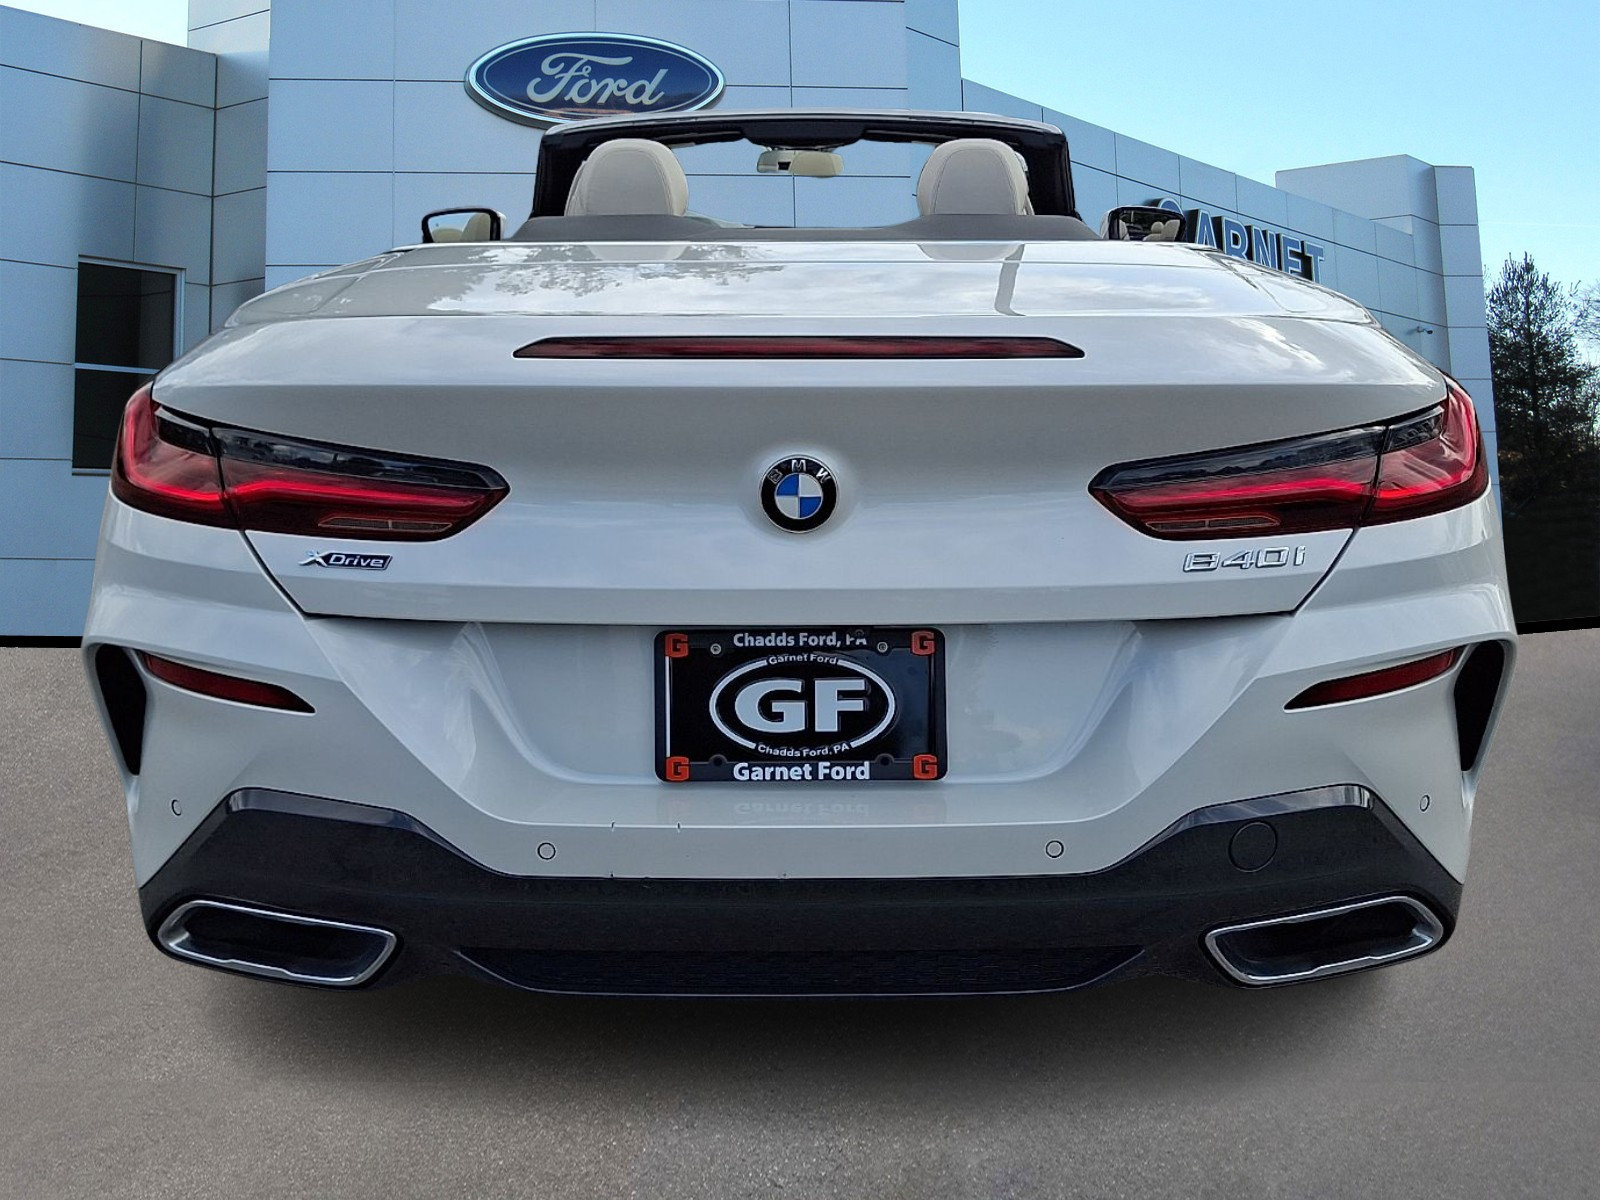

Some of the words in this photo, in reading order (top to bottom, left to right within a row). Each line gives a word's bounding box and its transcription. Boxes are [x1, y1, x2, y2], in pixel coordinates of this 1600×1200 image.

[526, 52, 669, 105] Ford
[1158, 197, 1324, 284] ARNET
[767, 459, 831, 484] BMW
[1183, 545, 1306, 572] 840i
[665, 633, 689, 658] G
[733, 633, 795, 647] Chadds
[799, 632, 841, 648] Ford,
[911, 631, 935, 656] G
[768, 653, 808, 665] Garnet
[810, 654, 838, 665] Ford
[734, 678, 866, 733] GF
[757, 744, 800, 757] Chadds
[833, 742, 849, 753] PA
[665, 756, 690, 782] G
[733, 763, 812, 781] Garnet
[818, 761, 870, 780] Ford
[913, 754, 938, 780] G
